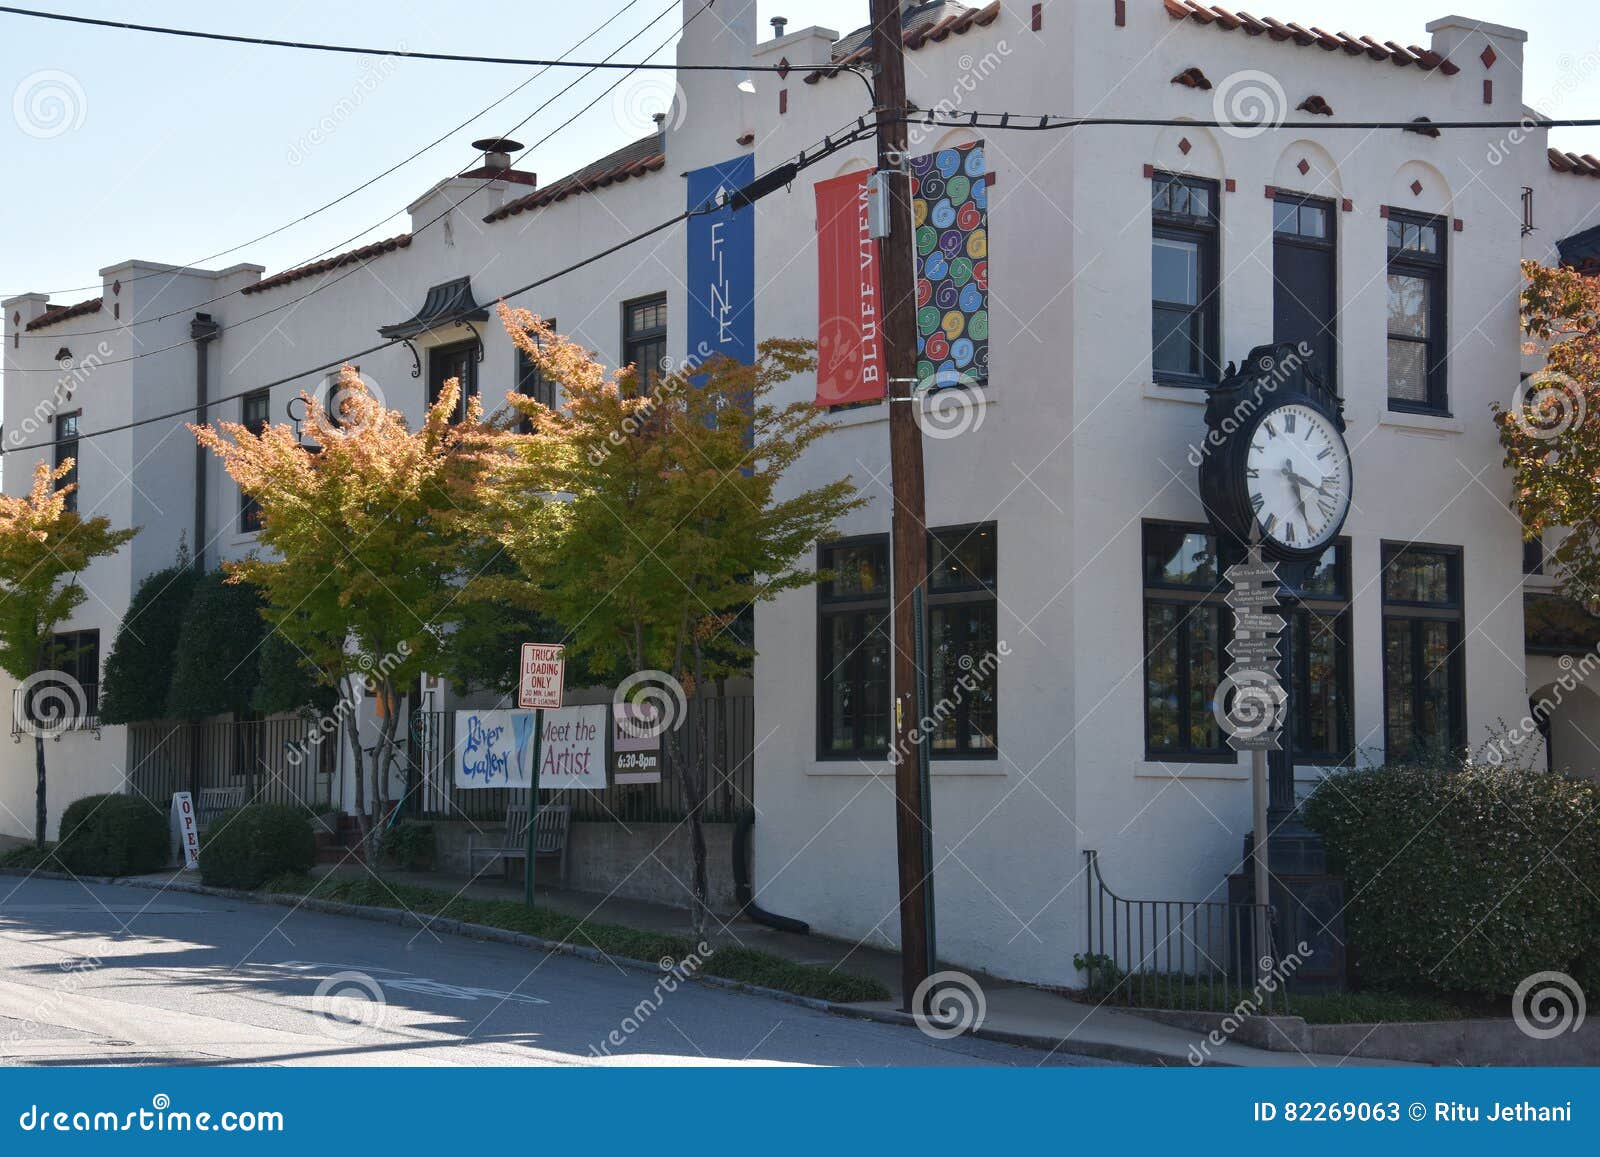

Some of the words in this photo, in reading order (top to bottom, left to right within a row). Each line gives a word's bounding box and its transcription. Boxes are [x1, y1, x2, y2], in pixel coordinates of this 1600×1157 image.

[711, 222, 732, 343] FINE
[862, 282, 879, 384] BLUFF
[532, 648, 556, 661] TRUCK
[526, 662, 558, 676] LOADING
[532, 676, 552, 688] ONLY
[468, 715, 504, 748] River
[575, 716, 596, 741] the
[616, 715, 658, 740] FRIDAY
[463, 743, 512, 784] Gallery
[541, 744, 592, 775] Artist
[618, 753, 656, 770] 6:30-8pm
[182, 800, 200, 861] OPEN
